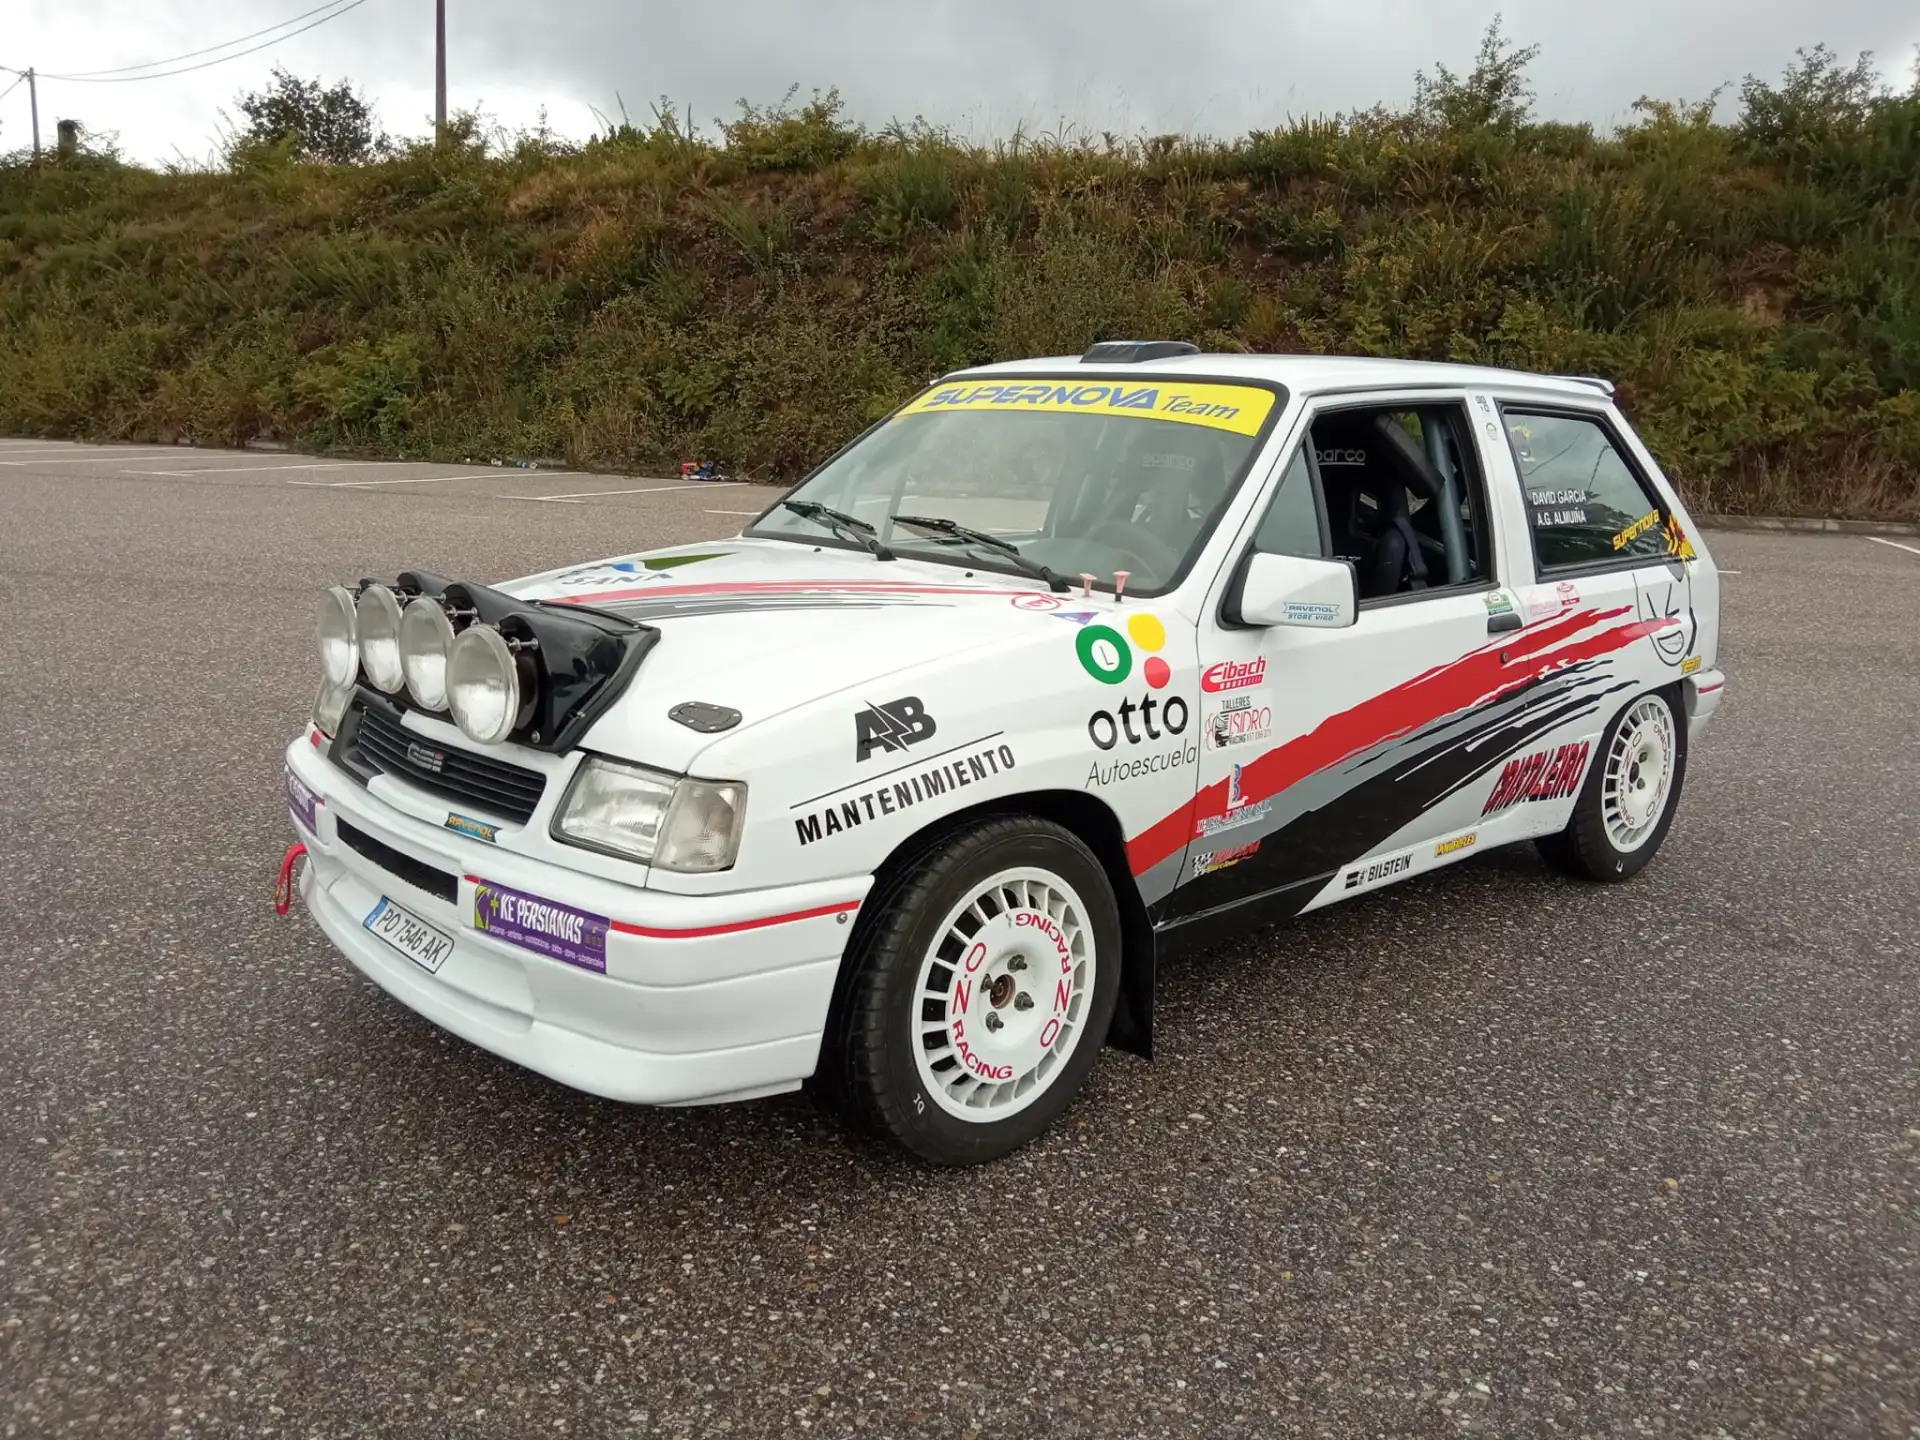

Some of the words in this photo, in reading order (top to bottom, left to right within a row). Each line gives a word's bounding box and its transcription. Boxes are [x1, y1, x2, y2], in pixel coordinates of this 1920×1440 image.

[922, 385, 1160, 409] SUPERNOVA
[1161, 395, 1241, 420] Team
[1314, 449, 1366, 462] parco
[1532, 490, 1556, 506] DAVID
[1287, 613, 1311, 621] STORE
[1315, 614, 1334, 622] VIGO
[1288, 604, 1334, 613] RAVENOL
[1201, 655, 1267, 693] Eibach
[1088, 692, 1189, 751] otto
[1221, 695, 1251, 710] TALLERES
[855, 695, 938, 763] AB
[1085, 738, 1197, 789] Autoescuela
[794, 744, 1016, 846] MANTENIMIENTO
[1368, 854, 1412, 881] BILSTEIN
[376, 907, 401, 933] PO
[393, 918, 427, 951] 7546
[418, 936, 448, 964] AK
[500, 893, 517, 922] KE
[517, 898, 584, 944] PERSIANAS
[1015, 913, 1072, 975] RACING
[952, 1019, 1013, 1080] RACING
